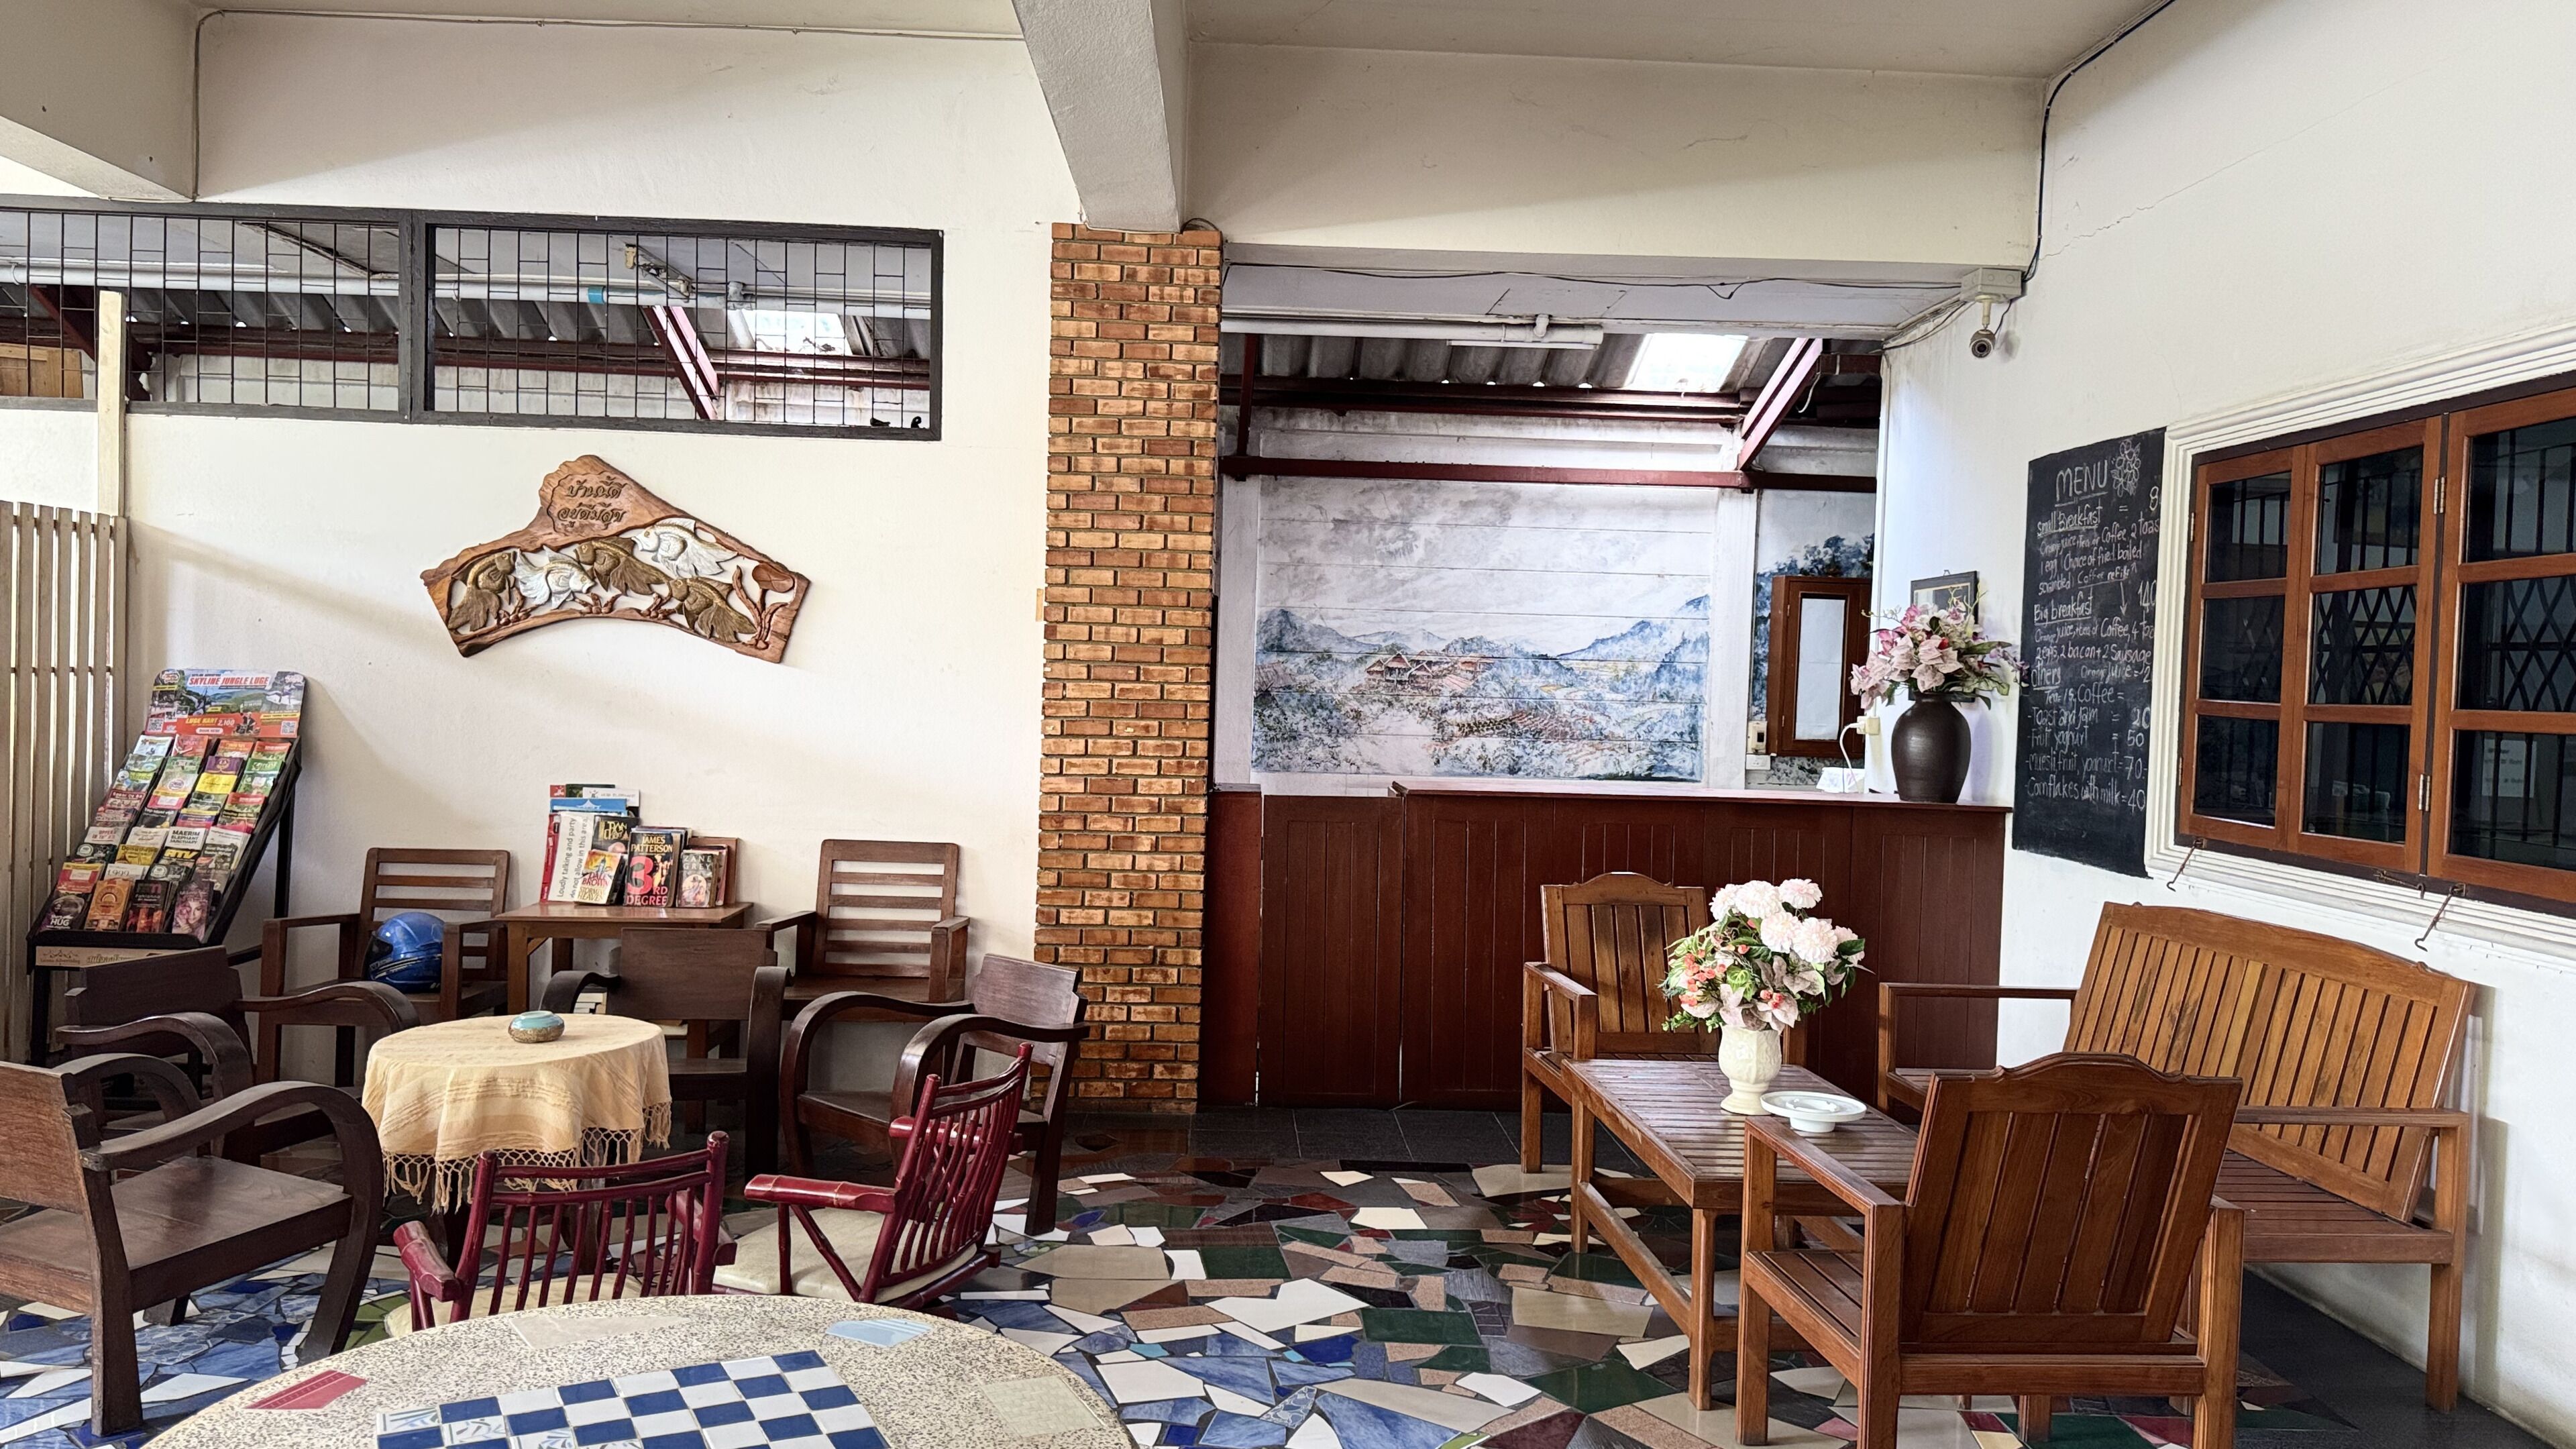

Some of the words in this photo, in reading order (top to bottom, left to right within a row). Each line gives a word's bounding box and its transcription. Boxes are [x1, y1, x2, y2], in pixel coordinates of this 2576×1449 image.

[2056, 460, 2108, 502] MENU
[2045, 558, 2057, 580] egg
[2087, 546, 2098, 566] of
[2078, 568, 2104, 584] Coffee
[2034, 604, 2048, 626] Big
[2051, 586, 2093, 618] breakfast
[2131, 621, 2140, 639] 4
[2068, 641, 2096, 659] bacon
[221, 677, 249, 685] JUNGLE
[250, 676, 269, 684] LUGE
[2078, 682, 2115, 704] Coffee
[2059, 703, 2076, 726] and
[2131, 706, 2151, 729] 20
[2127, 729, 2145, 747] 50
[2100, 777, 2121, 806] milk
[2128, 789, 2146, 813] 40
[569, 818, 577, 837] party
[631, 844, 673, 853] PATTERSON
[642, 835, 665, 845] JAMES
[562, 853, 574, 875] talking
[575, 858, 583, 875] allow
[557, 876, 568, 898] Loudly
[653, 886, 668, 895] RD
[626, 895, 667, 906] DEGREE
[50, 918, 70, 926] HUG
